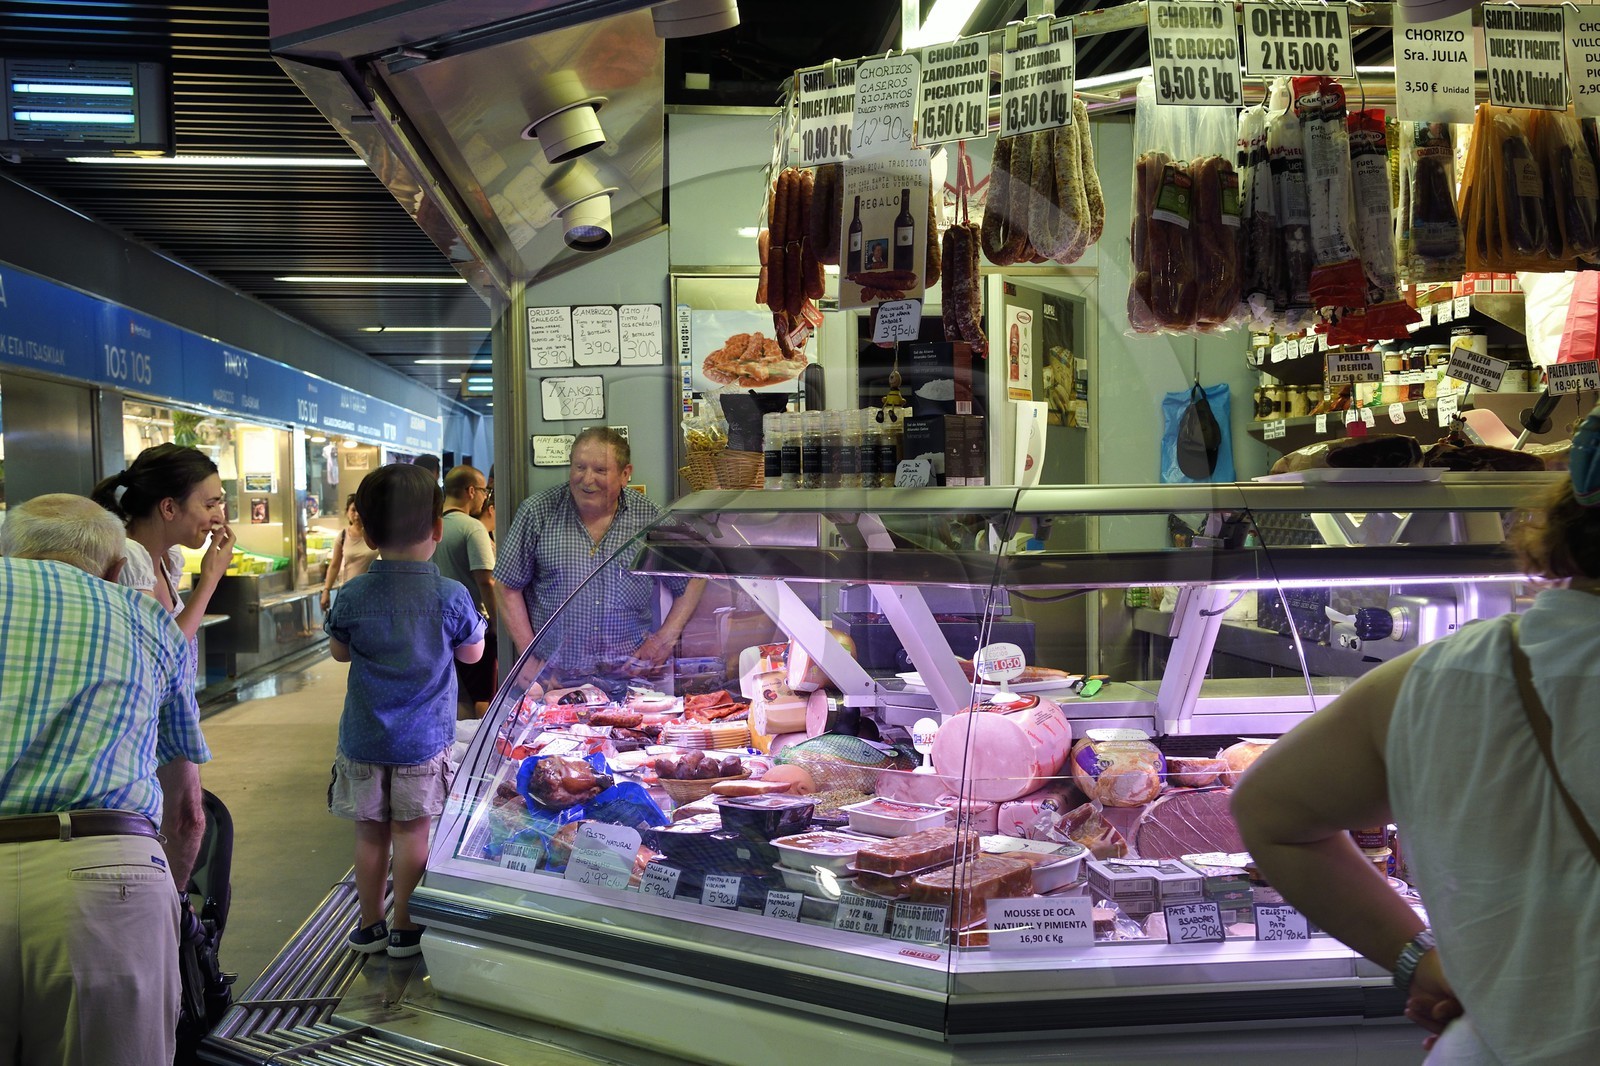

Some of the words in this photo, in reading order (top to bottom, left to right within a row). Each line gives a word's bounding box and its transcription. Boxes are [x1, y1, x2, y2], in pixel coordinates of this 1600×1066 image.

[1158, 6, 1223, 29] CHORIZO
[1252, 8, 1342, 38] OFERTA
[1486, 9, 1514, 30] SARTA
[1514, 11, 1562, 33] ALEJANDRO
[1405, 29, 1464, 42] CHORIZO
[928, 42, 979, 64] CHORIZO
[1154, 38, 1173, 59] DE
[1175, 38, 1236, 60] OROZCO
[1261, 41, 1272, 70] 2
[1274, 42, 1286, 70] X
[1288, 42, 1325, 73] 5,00
[1327, 43, 1339, 72] €
[1404, 49, 1428, 61] Sra.
[1432, 50, 1467, 63] JULIA
[1489, 38, 1516, 59] DULCE
[1517, 40, 1525, 58] Y
[1525, 40, 1561, 60] PICANTE
[1015, 56, 1026, 71] DE
[1027, 48, 1061, 69] ZAMORA
[860, 64, 913, 80] CHORIZOS
[922, 59, 987, 84] ZAMORANO
[1005, 74, 1029, 93] DULCE
[1030, 73, 1037, 87] Y
[1037, 65, 1072, 86] PICANTE
[859, 77, 908, 94] CASEROS
[924, 79, 984, 102] PICANTON
[1159, 66, 1196, 102] 9,50
[1198, 66, 1210, 100] €
[1212, 67, 1239, 104] kg.
[1405, 81, 1429, 94] 3,50
[1431, 82, 1438, 93] €
[1443, 86, 1469, 94] Unidad
[1492, 68, 1517, 105] 3,90
[1517, 70, 1525, 104] €
[1525, 71, 1563, 106] Unidad
[861, 89, 913, 104] RIOJANOS
[801, 99, 823, 120] DULCE
[823, 99, 830, 117] Y
[829, 94, 855, 115] PICANT
[1006, 93, 1037, 132] 13,50
[1040, 91, 1049, 124] €
[1051, 89, 1070, 124] kg.
[922, 103, 954, 141] 15,50
[955, 102, 964, 134] €
[966, 101, 984, 136] kg.
[802, 127, 828, 163] 10,90
[830, 125, 837, 157] €
[861, 195, 901, 211] REGALO
[530, 309, 560, 317] ORUJOS
[573, 308, 613, 316] LAMBRUSCO
[8, 338, 24, 357] ETA
[1338, 353, 1370, 361] PALETA
[104, 344, 128, 381] 103
[131, 350, 152, 386] 105
[223, 350, 249, 380] TINO'S
[1337, 363, 1373, 372] IBERICA
[1467, 352, 1491, 366] PALETA
[1357, 373, 1363, 381] €
[1452, 358, 1471, 371] GRAN
[1471, 364, 1501, 380] RESERVA
[1548, 365, 1568, 378] PALETA
[1569, 364, 1577, 376] DE
[606, 839, 632, 850] NATURAL
[840, 894, 864, 907] CALLOS
[865, 898, 888, 910] ROJOS
[1168, 907, 1185, 916] PATE
[1187, 906, 1198, 914] DE
[1199, 905, 1216, 913] PATO
[848, 908, 860, 918] 1/2
[862, 911, 874, 921] Kg.
[896, 904, 921, 921] CALLOS
[922, 907, 944, 923] ROJOS
[1004, 909, 1040, 918] MOUSSE
[1043, 909, 1055, 917] DE
[1056, 908, 1075, 917] OCA
[1036, 922, 1042, 930] Y
[1044, 920, 1087, 930] PIMIENTA
[1020, 934, 1043, 944] 16,90
[1045, 934, 1051, 942] €
[1052, 934, 1063, 944] Kg
